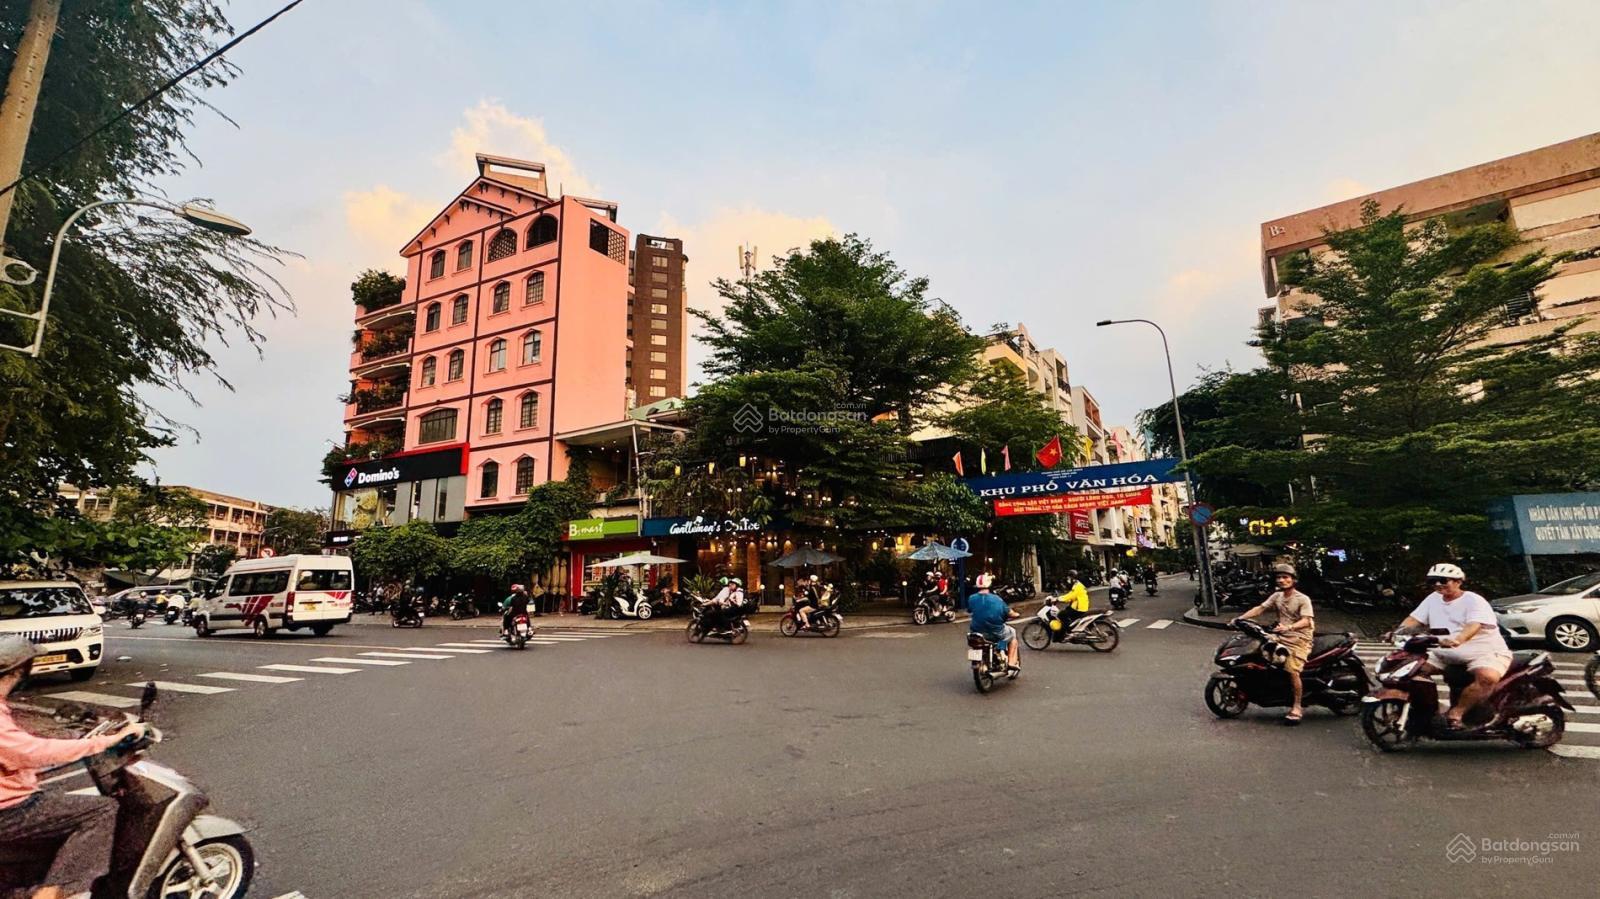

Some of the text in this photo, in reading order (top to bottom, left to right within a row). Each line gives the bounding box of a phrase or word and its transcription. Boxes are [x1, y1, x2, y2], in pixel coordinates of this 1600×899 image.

[358, 467, 400, 484] Domino's
[980, 485, 1015, 497] KHU
[1021, 479, 1058, 494] PHỐ
[1066, 477, 1106, 489] VĂN
[1112, 474, 1158, 486] HÓA
